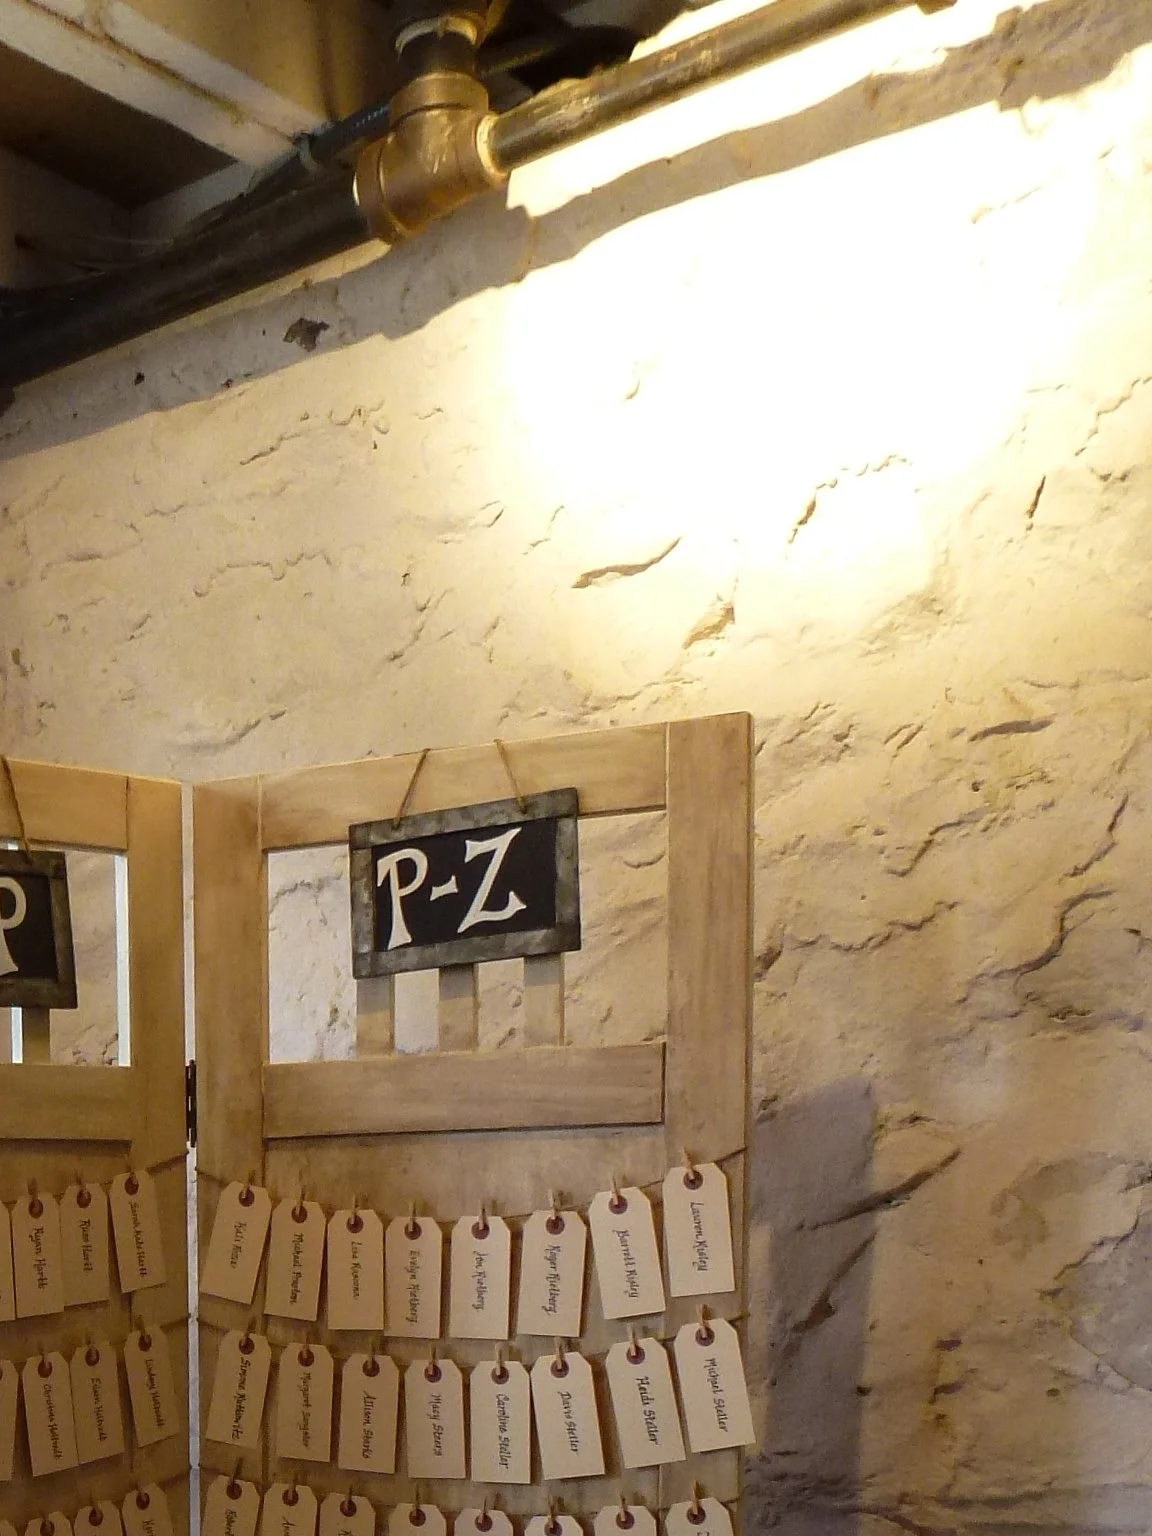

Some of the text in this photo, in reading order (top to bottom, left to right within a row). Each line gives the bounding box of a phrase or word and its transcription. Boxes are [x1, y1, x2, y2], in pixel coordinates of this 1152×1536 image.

[377, 827, 527, 950] P-Z
[689, 1201, 704, 1242] Lauren
[28, 1225, 49, 1290] Ryan Hartt
[636, 1375, 655, 1407] Heidi
[703, 1357, 724, 1395] Michael
[362, 1390, 376, 1427] Allison
[495, 1393, 510, 1434] Caroline
